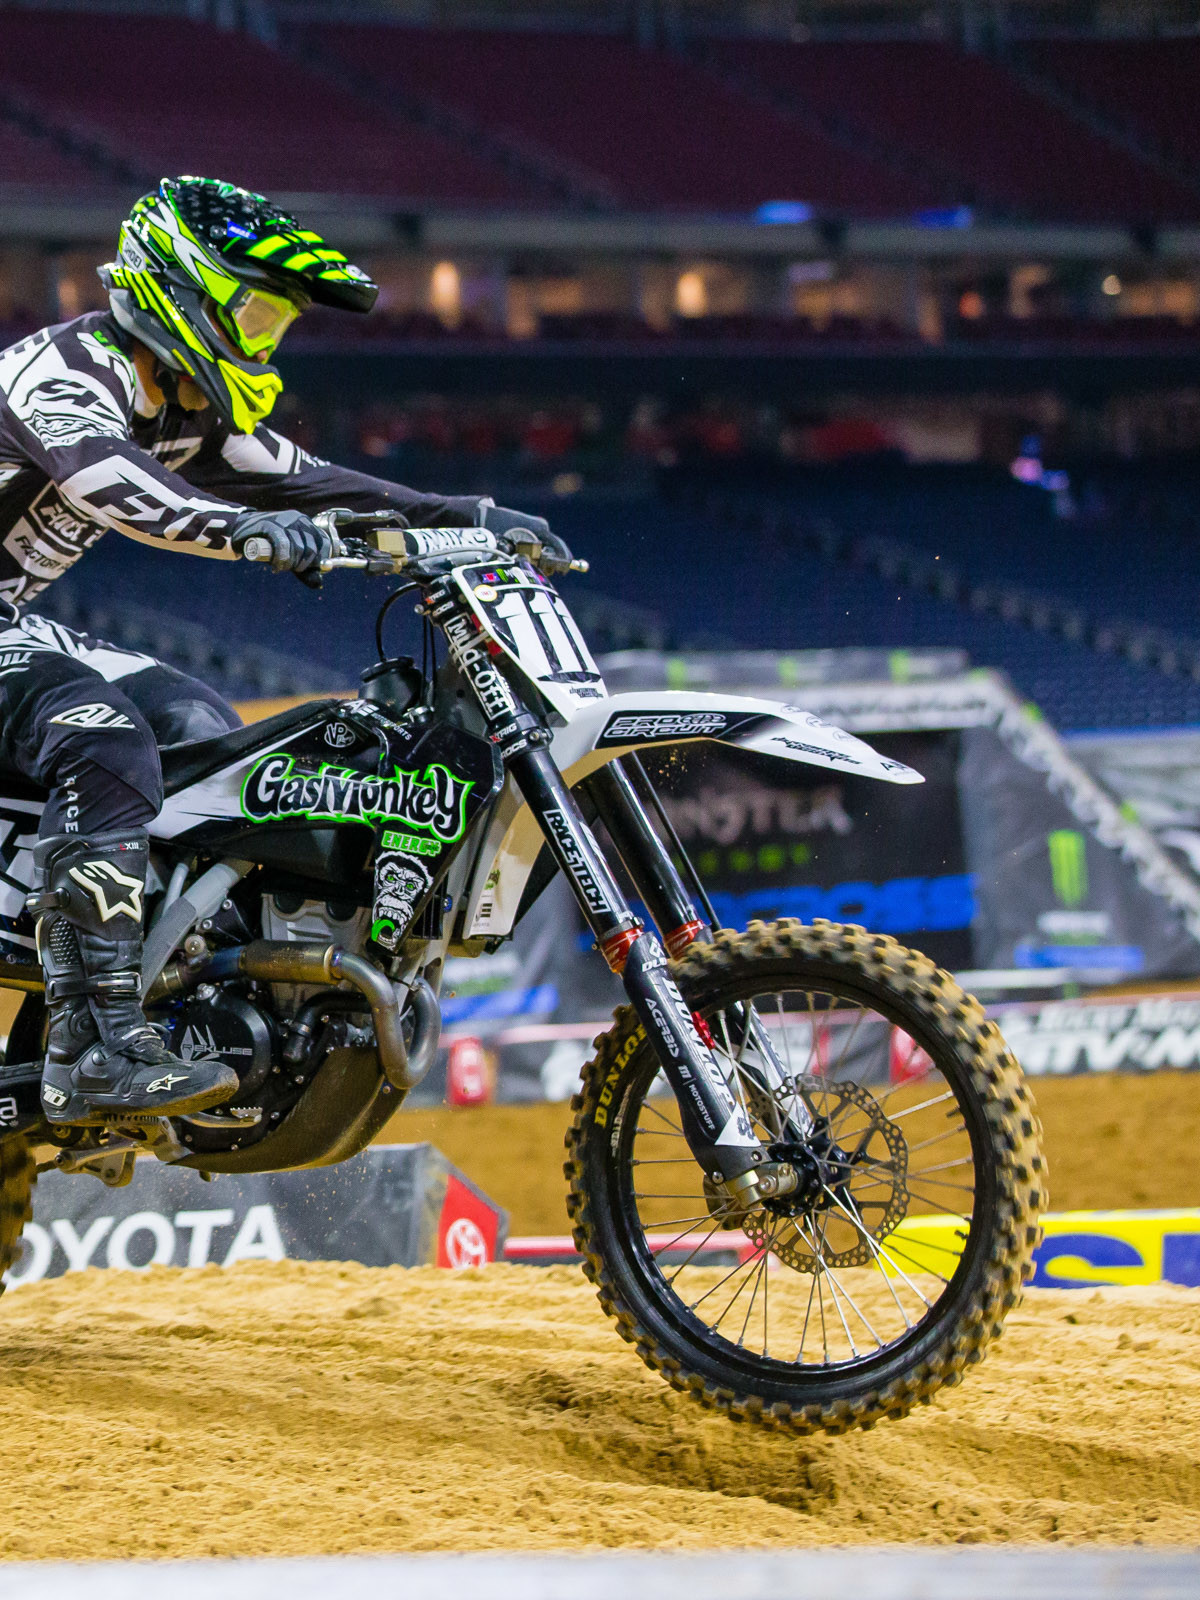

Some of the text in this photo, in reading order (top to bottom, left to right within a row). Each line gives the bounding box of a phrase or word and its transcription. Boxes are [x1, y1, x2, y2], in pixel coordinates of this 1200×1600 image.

[495, 591, 601, 676] 111
[490, 722, 518, 743] XTRIG
[603, 723, 727, 738] CIRCUIT
[612, 715, 682, 728] PRO
[63, 776, 79, 834] RACE
[381, 830, 442, 856] ENERGY
[181, 1042, 253, 1056] REKLUSE
[645, 998, 680, 1058] ACERBIS
[662, 975, 737, 1111] DUNLOP
[689, 1083, 716, 1131] MOTOSTUFF
[3, 1204, 288, 1292] OYOTA
